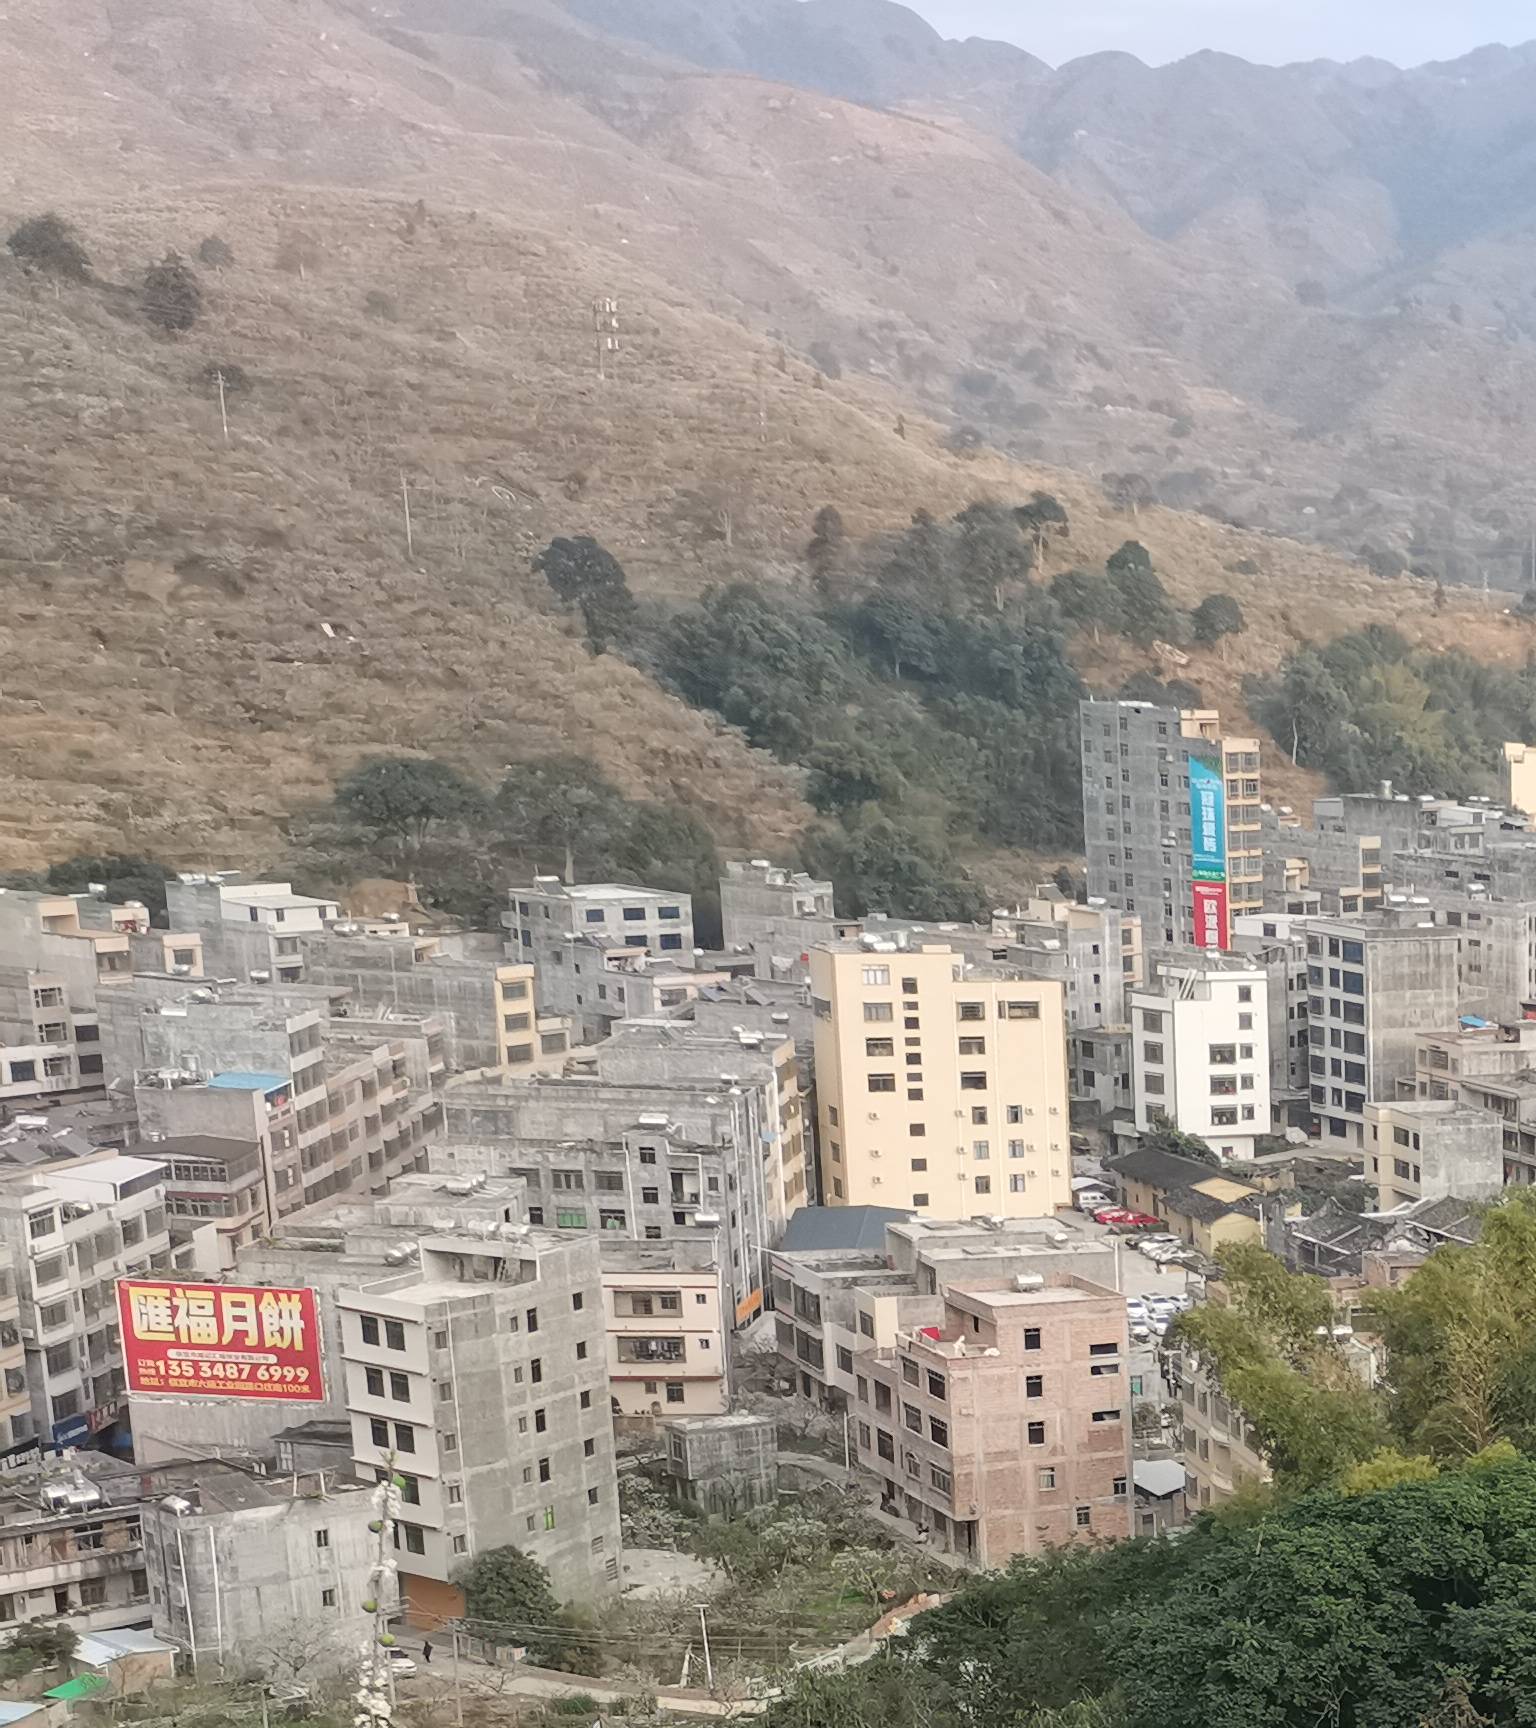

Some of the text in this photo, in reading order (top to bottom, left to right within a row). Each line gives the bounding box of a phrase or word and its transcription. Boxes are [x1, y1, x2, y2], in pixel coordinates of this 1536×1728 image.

[129, 1286, 305, 1351] 匯福月餅
[156, 1359, 310, 1383] 135 3487 6999
